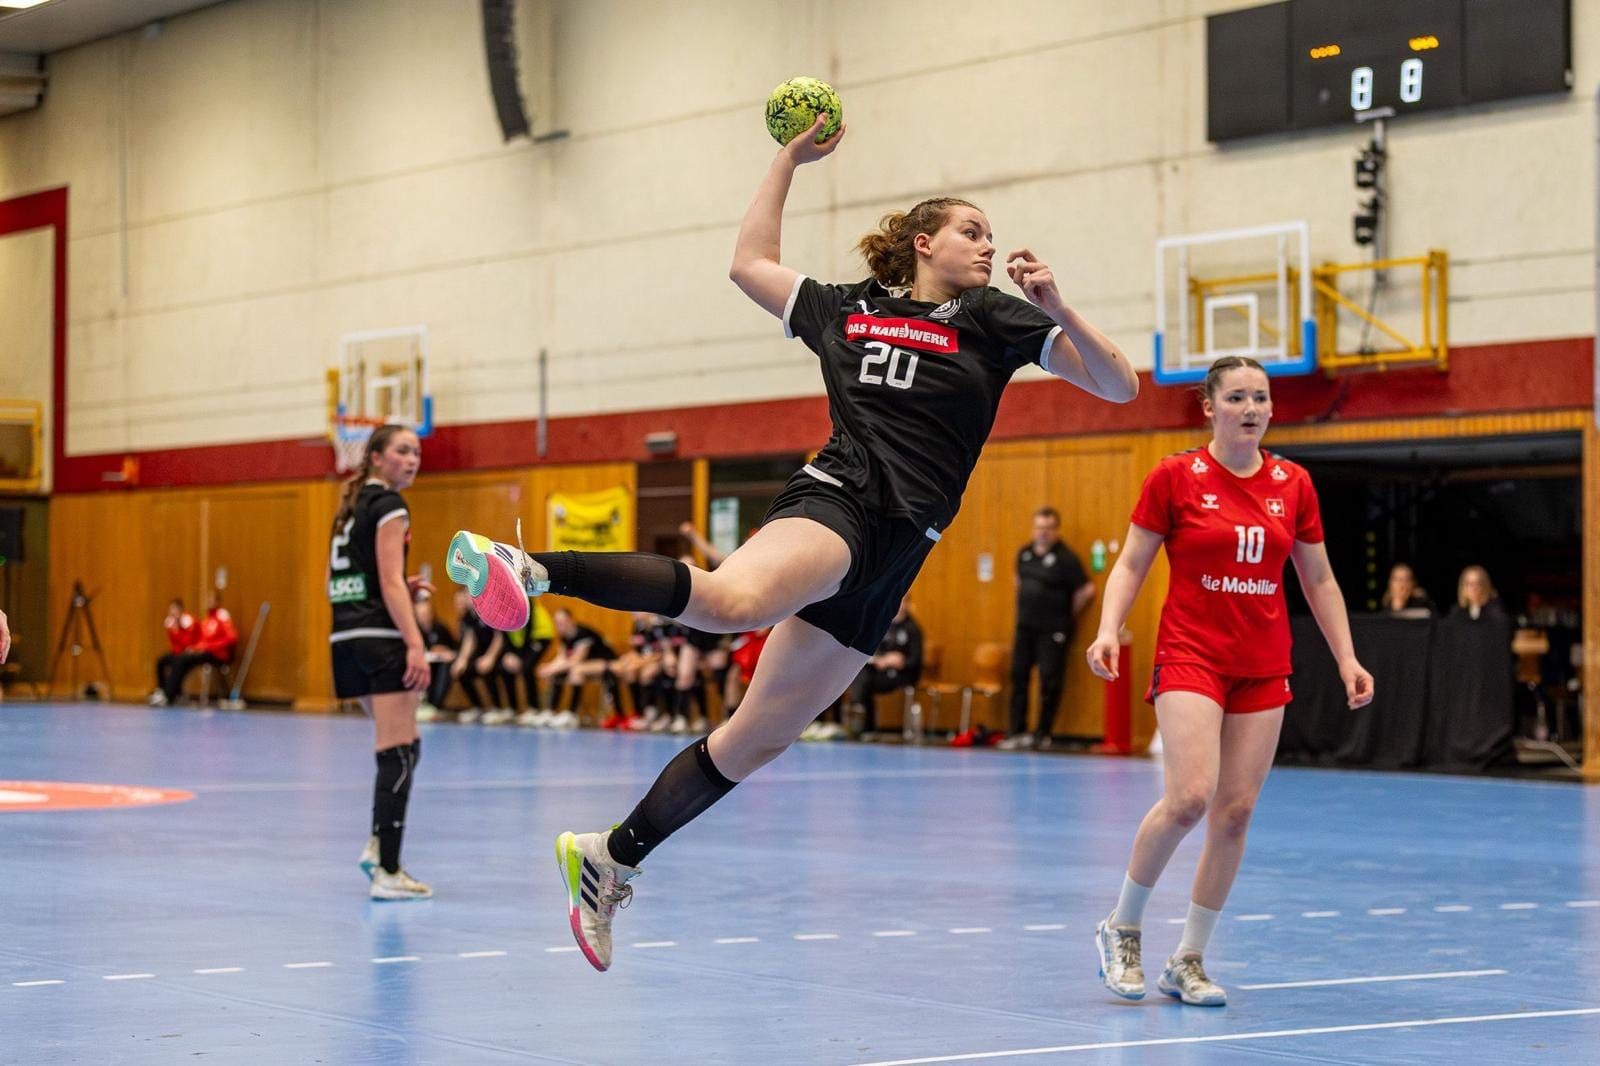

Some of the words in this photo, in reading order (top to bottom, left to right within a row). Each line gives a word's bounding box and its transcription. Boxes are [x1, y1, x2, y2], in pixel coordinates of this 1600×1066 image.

[1351, 66, 1373, 110] 8
[1400, 58, 1423, 102] 8
[847, 323, 868, 334] DAS
[869, 323, 949, 347] HANDWERK
[859, 341, 919, 389] 20
[1234, 525, 1265, 563] 10
[1222, 576, 1278, 595] Mobiliar
